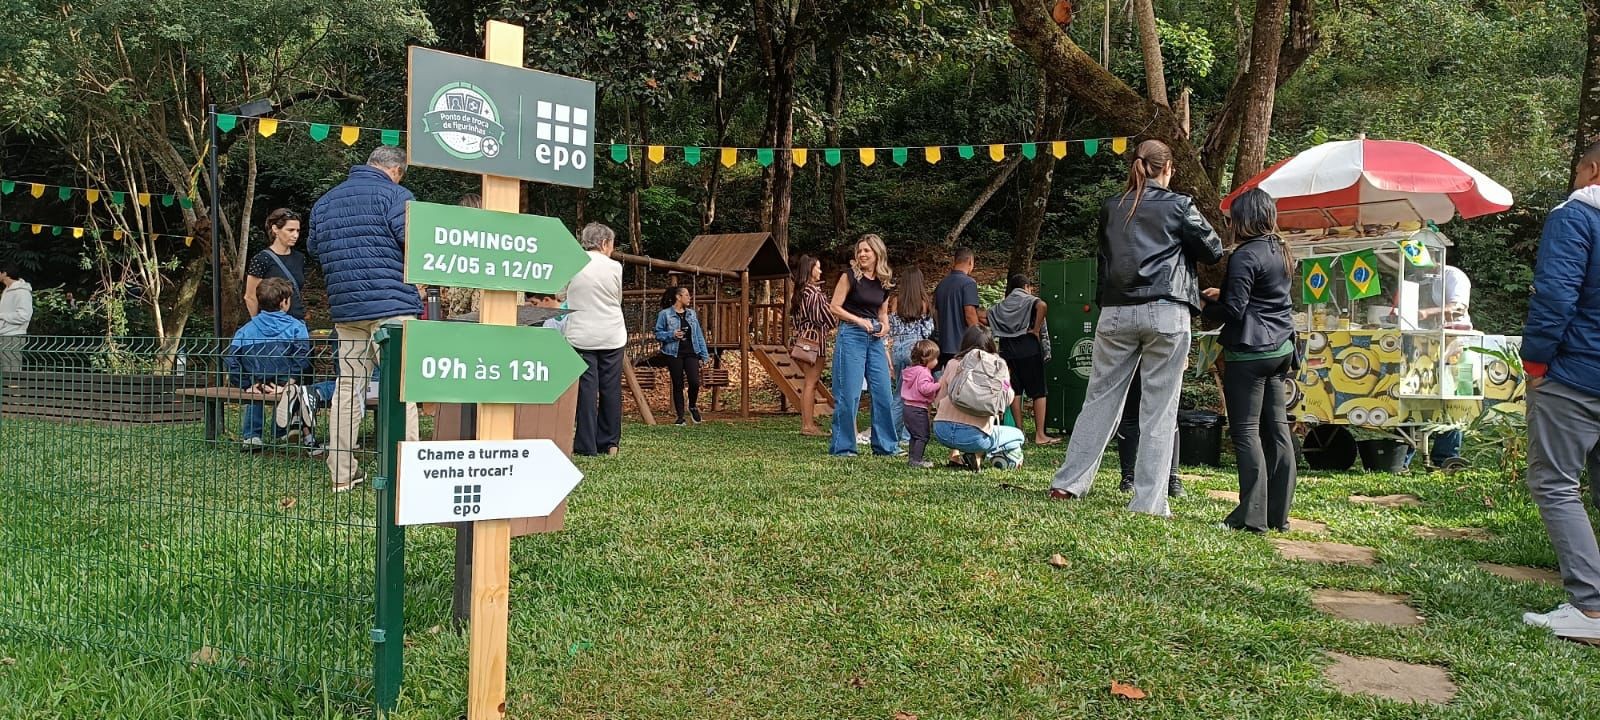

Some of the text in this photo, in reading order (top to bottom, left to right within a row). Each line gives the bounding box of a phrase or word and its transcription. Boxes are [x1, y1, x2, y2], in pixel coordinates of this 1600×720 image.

[440, 112, 489, 129] Ponto de troca
[442, 120, 486, 136] de figurinhas
[536, 143, 587, 171] epo
[434, 226, 539, 254] DOMINGOS
[423, 253, 554, 281] 24/05 a 12/07
[421, 356, 549, 382] 09h às 13h
[417, 448, 530, 461] Chame a turma e
[423, 464, 514, 479] venha trocar!
[453, 504, 481, 517] epo
